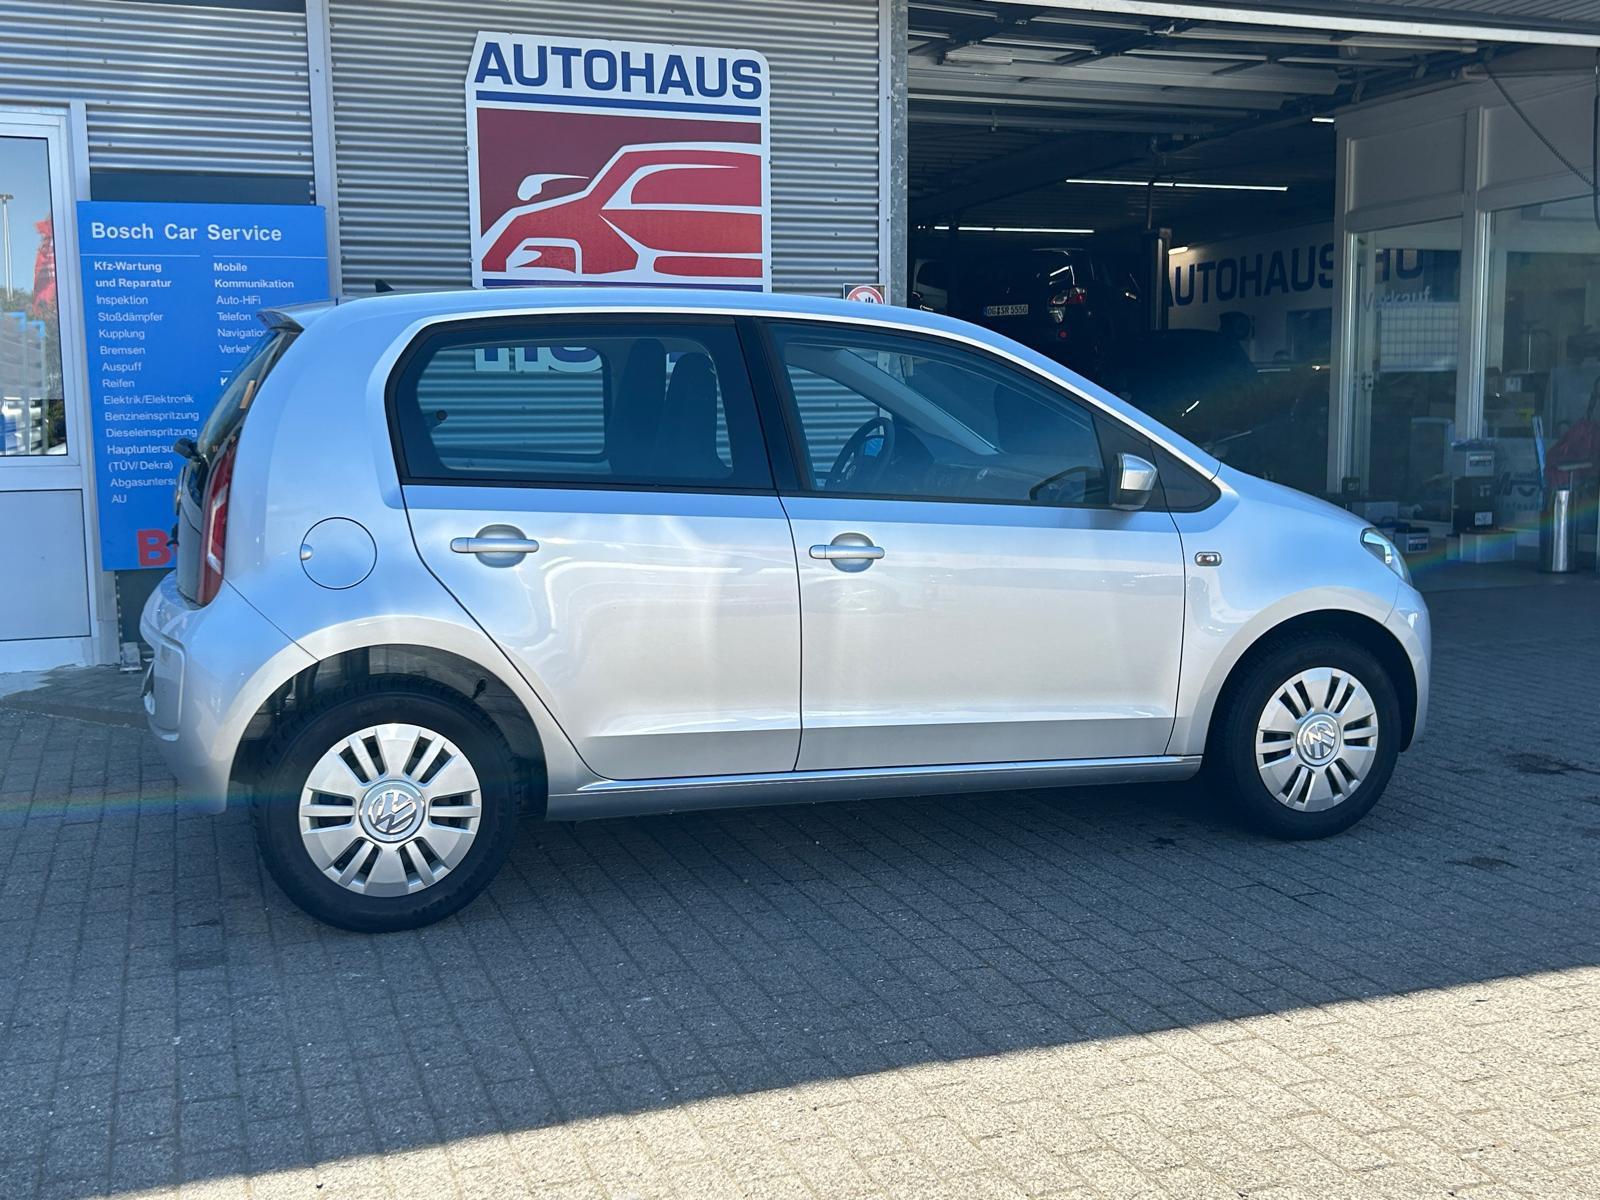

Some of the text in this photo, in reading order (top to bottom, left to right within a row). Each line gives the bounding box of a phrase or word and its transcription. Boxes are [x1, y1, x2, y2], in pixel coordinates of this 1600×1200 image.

[474, 41, 762, 100] AUTOHAUS
[91, 222, 282, 241] Bosch Car Service
[94, 261, 162, 273] Kfz-Wartung
[213, 262, 248, 272] Mobile
[95, 278, 172, 290] und Reparatur
[214, 279, 295, 289] Kommunikation
[96, 295, 149, 306] Inspektion
[216, 295, 261, 305] Auto-HiFi
[97, 311, 164, 323] Stoßdämpfer
[217, 312, 252, 321] Telefon
[98, 329, 145, 340] Kupplung
[100, 345, 146, 355] Bremsen
[102, 362, 142, 373] Auspuff
[102, 379, 135, 388] Reifen
[103, 395, 195, 405] Elektrik/Elektronik
[104, 411, 200, 422] Benzineinspritzung
[105, 428, 198, 438] Dieseleinspritzung
[111, 494, 128, 504] AU
